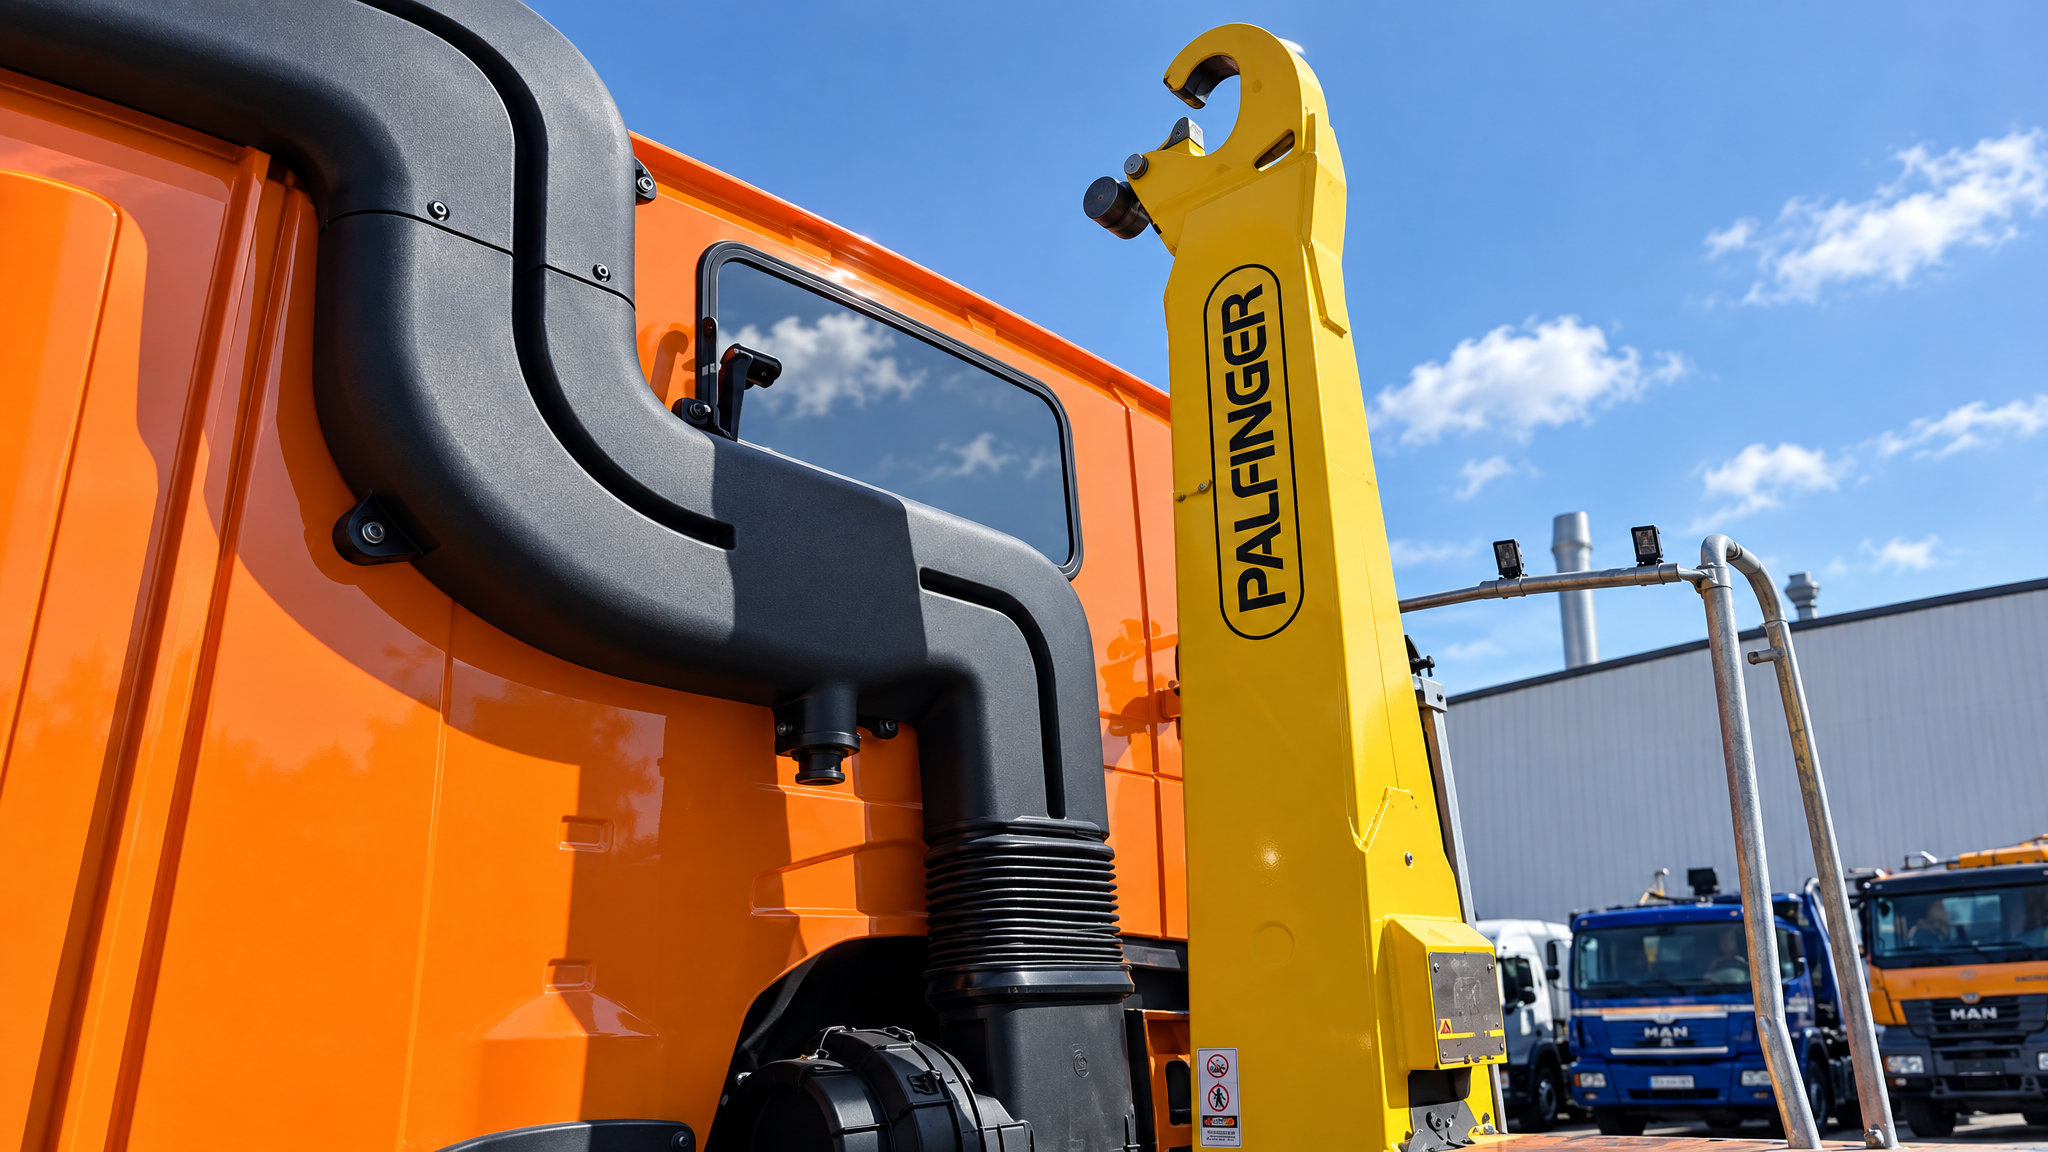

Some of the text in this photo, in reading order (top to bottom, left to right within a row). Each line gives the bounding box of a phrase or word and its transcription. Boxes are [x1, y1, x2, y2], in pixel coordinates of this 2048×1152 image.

[1221, 283, 1287, 613] PALFINGER
[1949, 1007, 1998, 1020] MAN
[1644, 1026, 1688, 1038] MAN
